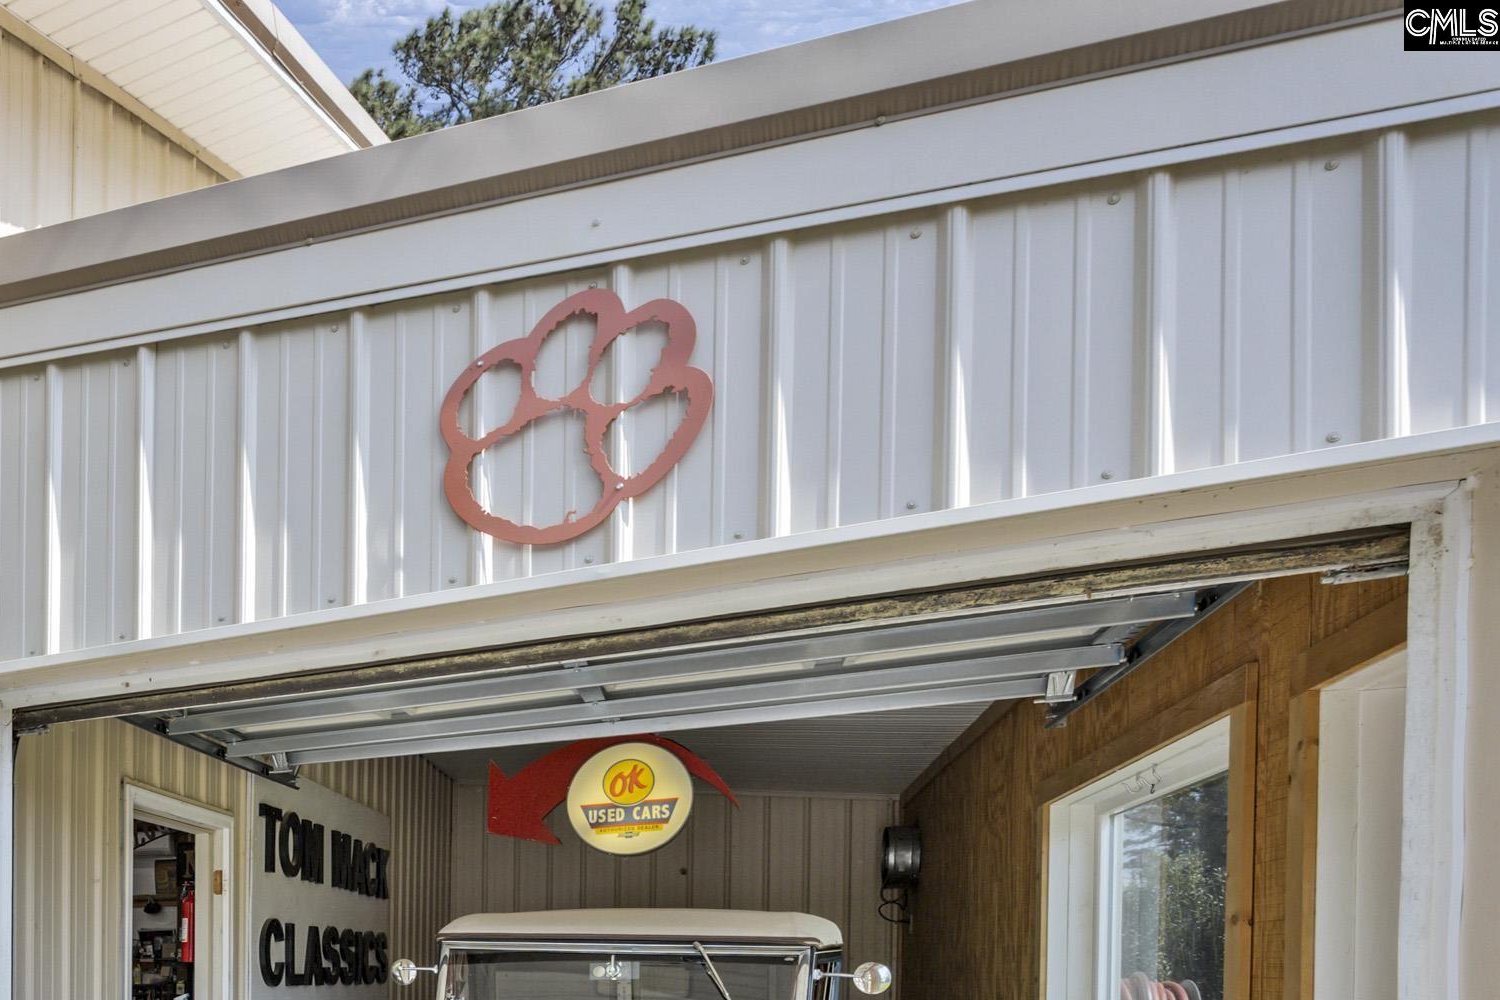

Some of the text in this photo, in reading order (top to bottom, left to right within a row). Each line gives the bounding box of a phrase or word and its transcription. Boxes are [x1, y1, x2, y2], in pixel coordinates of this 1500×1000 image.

[609, 764, 648, 798] OK
[588, 804, 670, 824] USED CARS
[258, 803, 390, 900] TOM MACK
[258, 918, 389, 988] CLASSICS
